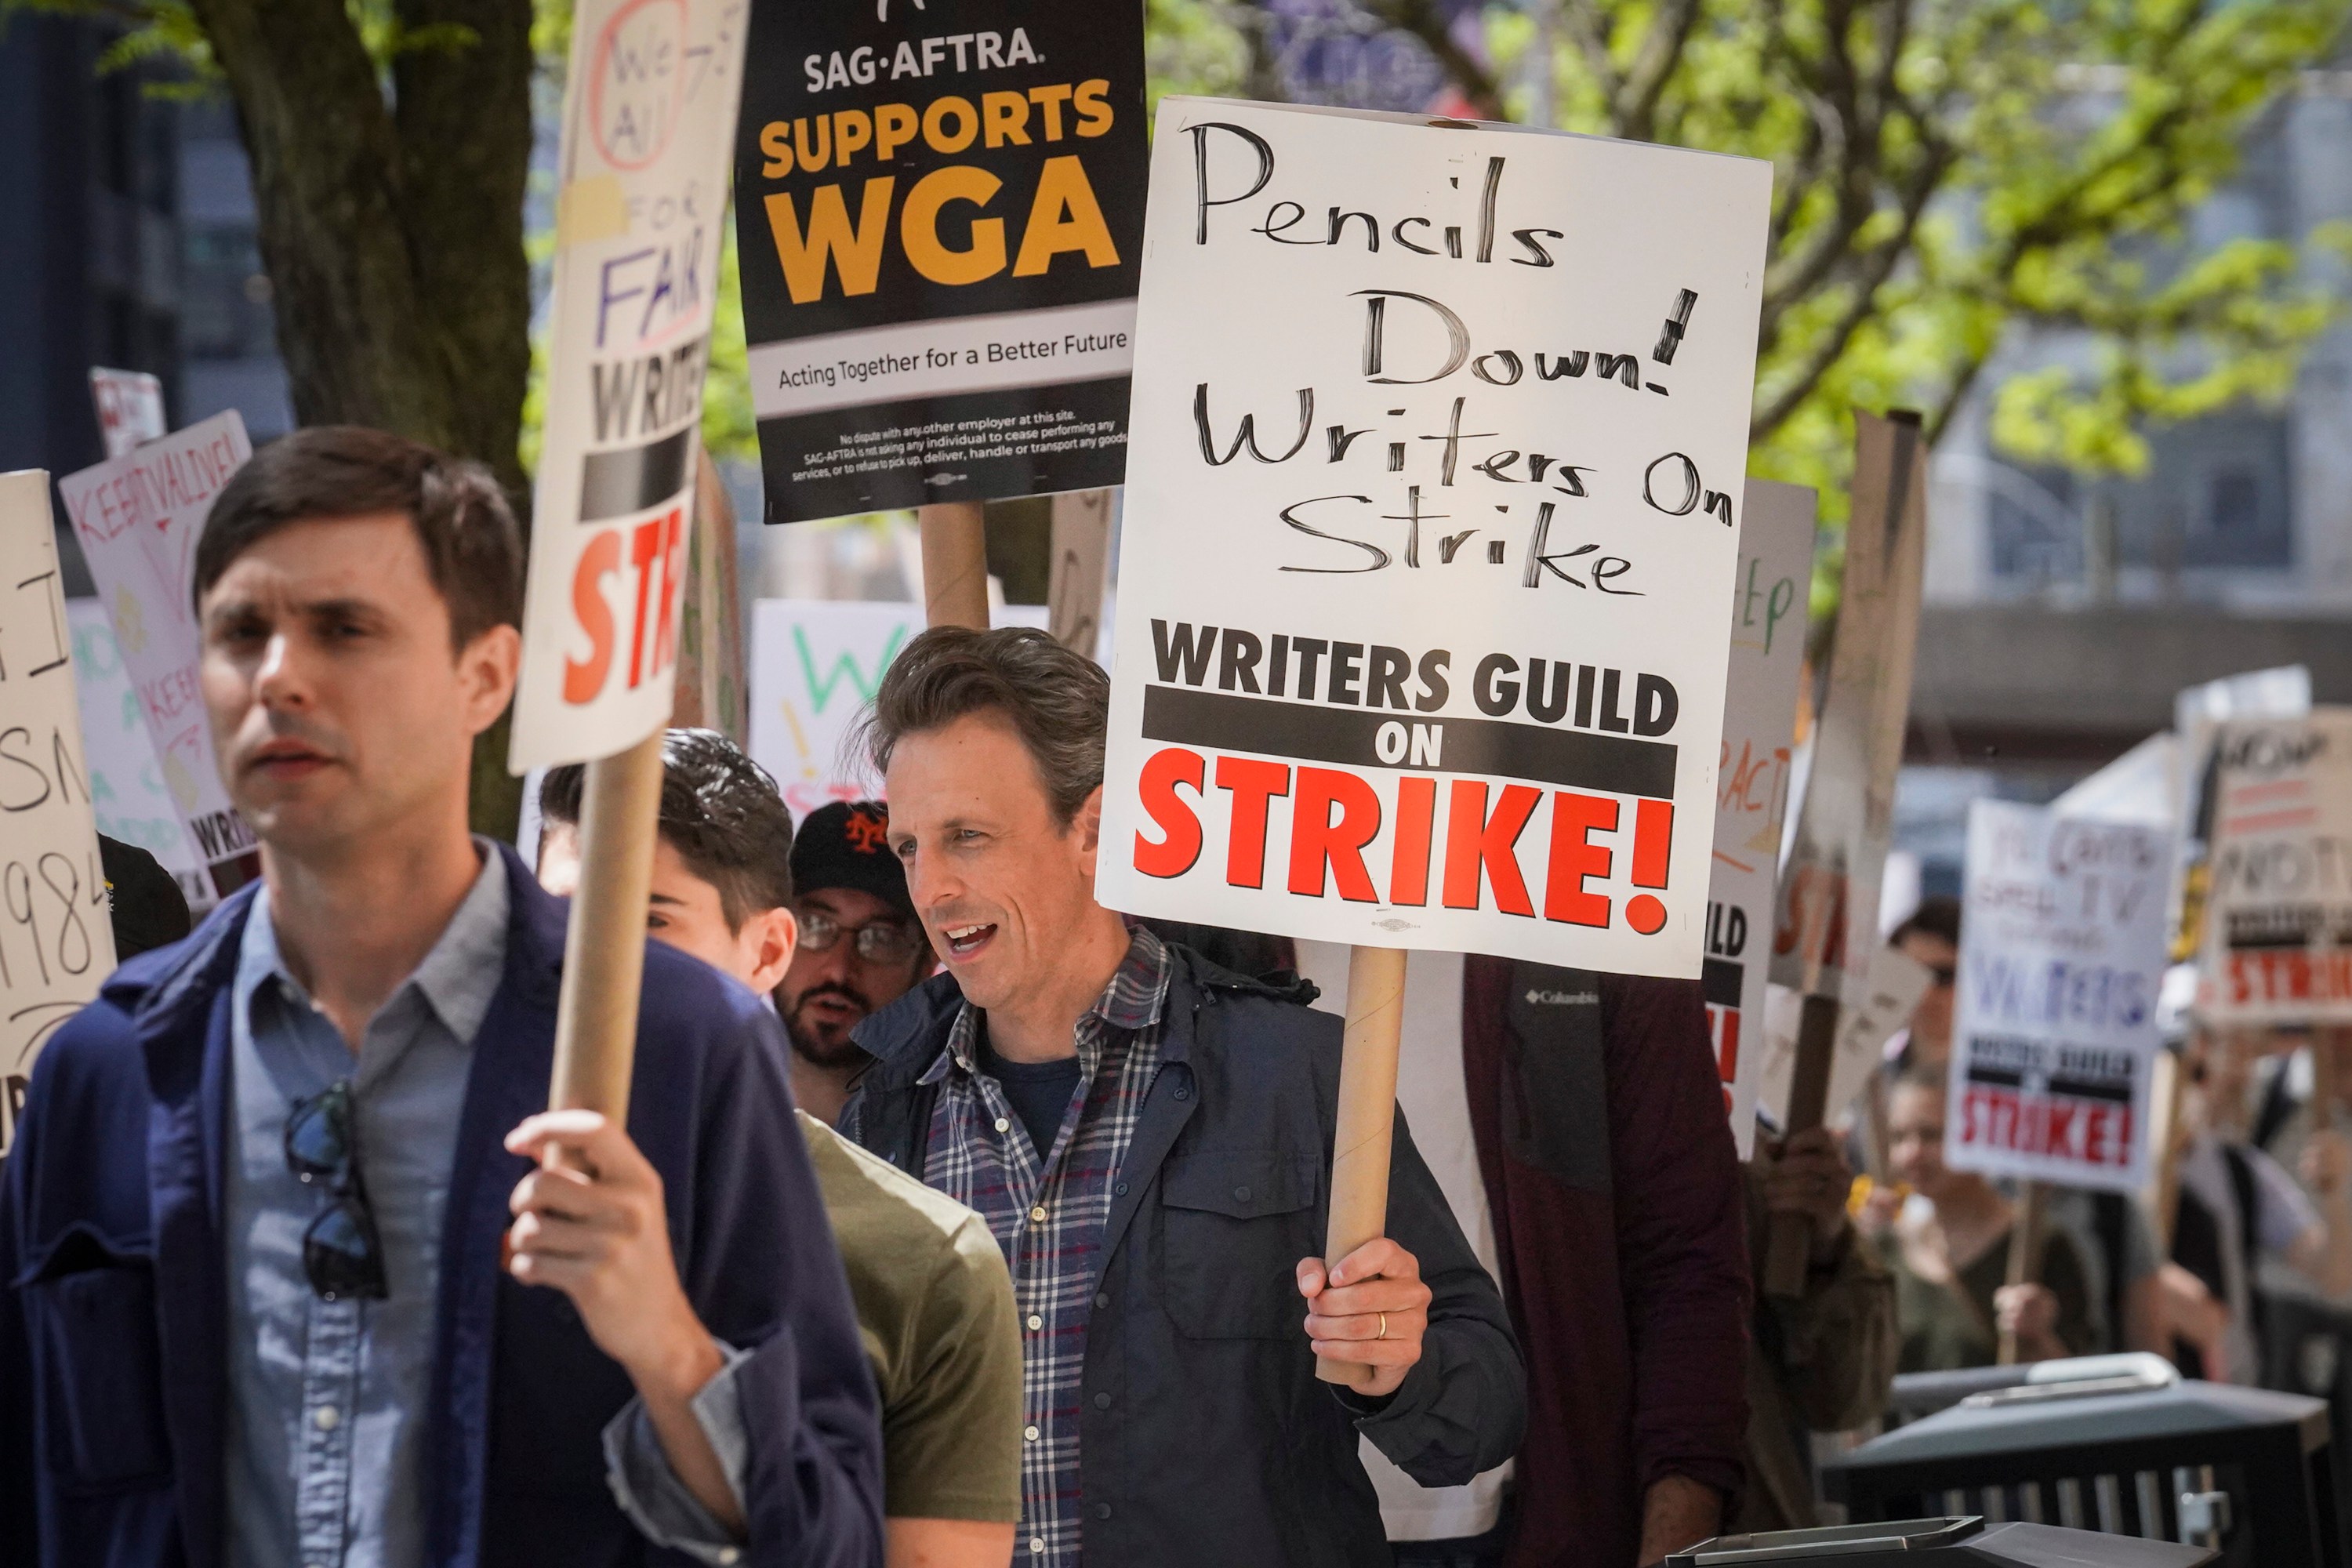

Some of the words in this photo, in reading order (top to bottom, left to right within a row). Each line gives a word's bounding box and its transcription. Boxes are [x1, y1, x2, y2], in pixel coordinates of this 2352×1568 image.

[759, 78, 1115, 180] SUPPORTS
[763, 154, 1121, 305] WGA
[1178, 117, 1564, 267] Pencils
[779, 364, 837, 389] Acting
[838, 350, 920, 382] Together
[926, 347, 958, 369] for
[965, 347, 979, 365] a
[988, 338, 1058, 363] Better
[1064, 330, 1128, 354] Future
[1347, 289, 1698, 397] Down!
[832, 465, 843, 476] or
[844, 463, 855, 474] to
[924, 450, 967, 464] deliver,
[969, 445, 1013, 459] handle
[1015, 444, 1029, 456] or
[1030, 437, 1078, 453] transport
[1079, 437, 1098, 449] any
[840, 434, 853, 445] No
[883, 426, 902, 439] with
[902, 425, 923, 438] any
[923, 421, 955, 435] other
[957, 416, 1016, 430] employer
[1018, 415, 1031, 426] at
[1033, 411, 1054, 424] this
[1055, 409, 1076, 421] site.
[906, 440, 925, 452] any
[926, 433, 986, 448] individual
[989, 431, 1002, 443] to
[1004, 429, 1039, 442] cease
[1040, 421, 1096, 439] performing
[1097, 419, 1116, 433] any
[1193, 383, 1598, 498] Writers
[1642, 452, 1733, 528] On
[1277, 485, 1646, 597] Strike
[1733, 554, 1795, 655] EP
[1150, 618, 1452, 713] WRITERS
[1472, 652, 1679, 737] GUILD
[1374, 720, 1444, 768] ON
[1133, 747, 1675, 936] STRIKE!
[1538, 990, 1600, 1004] Columbia
